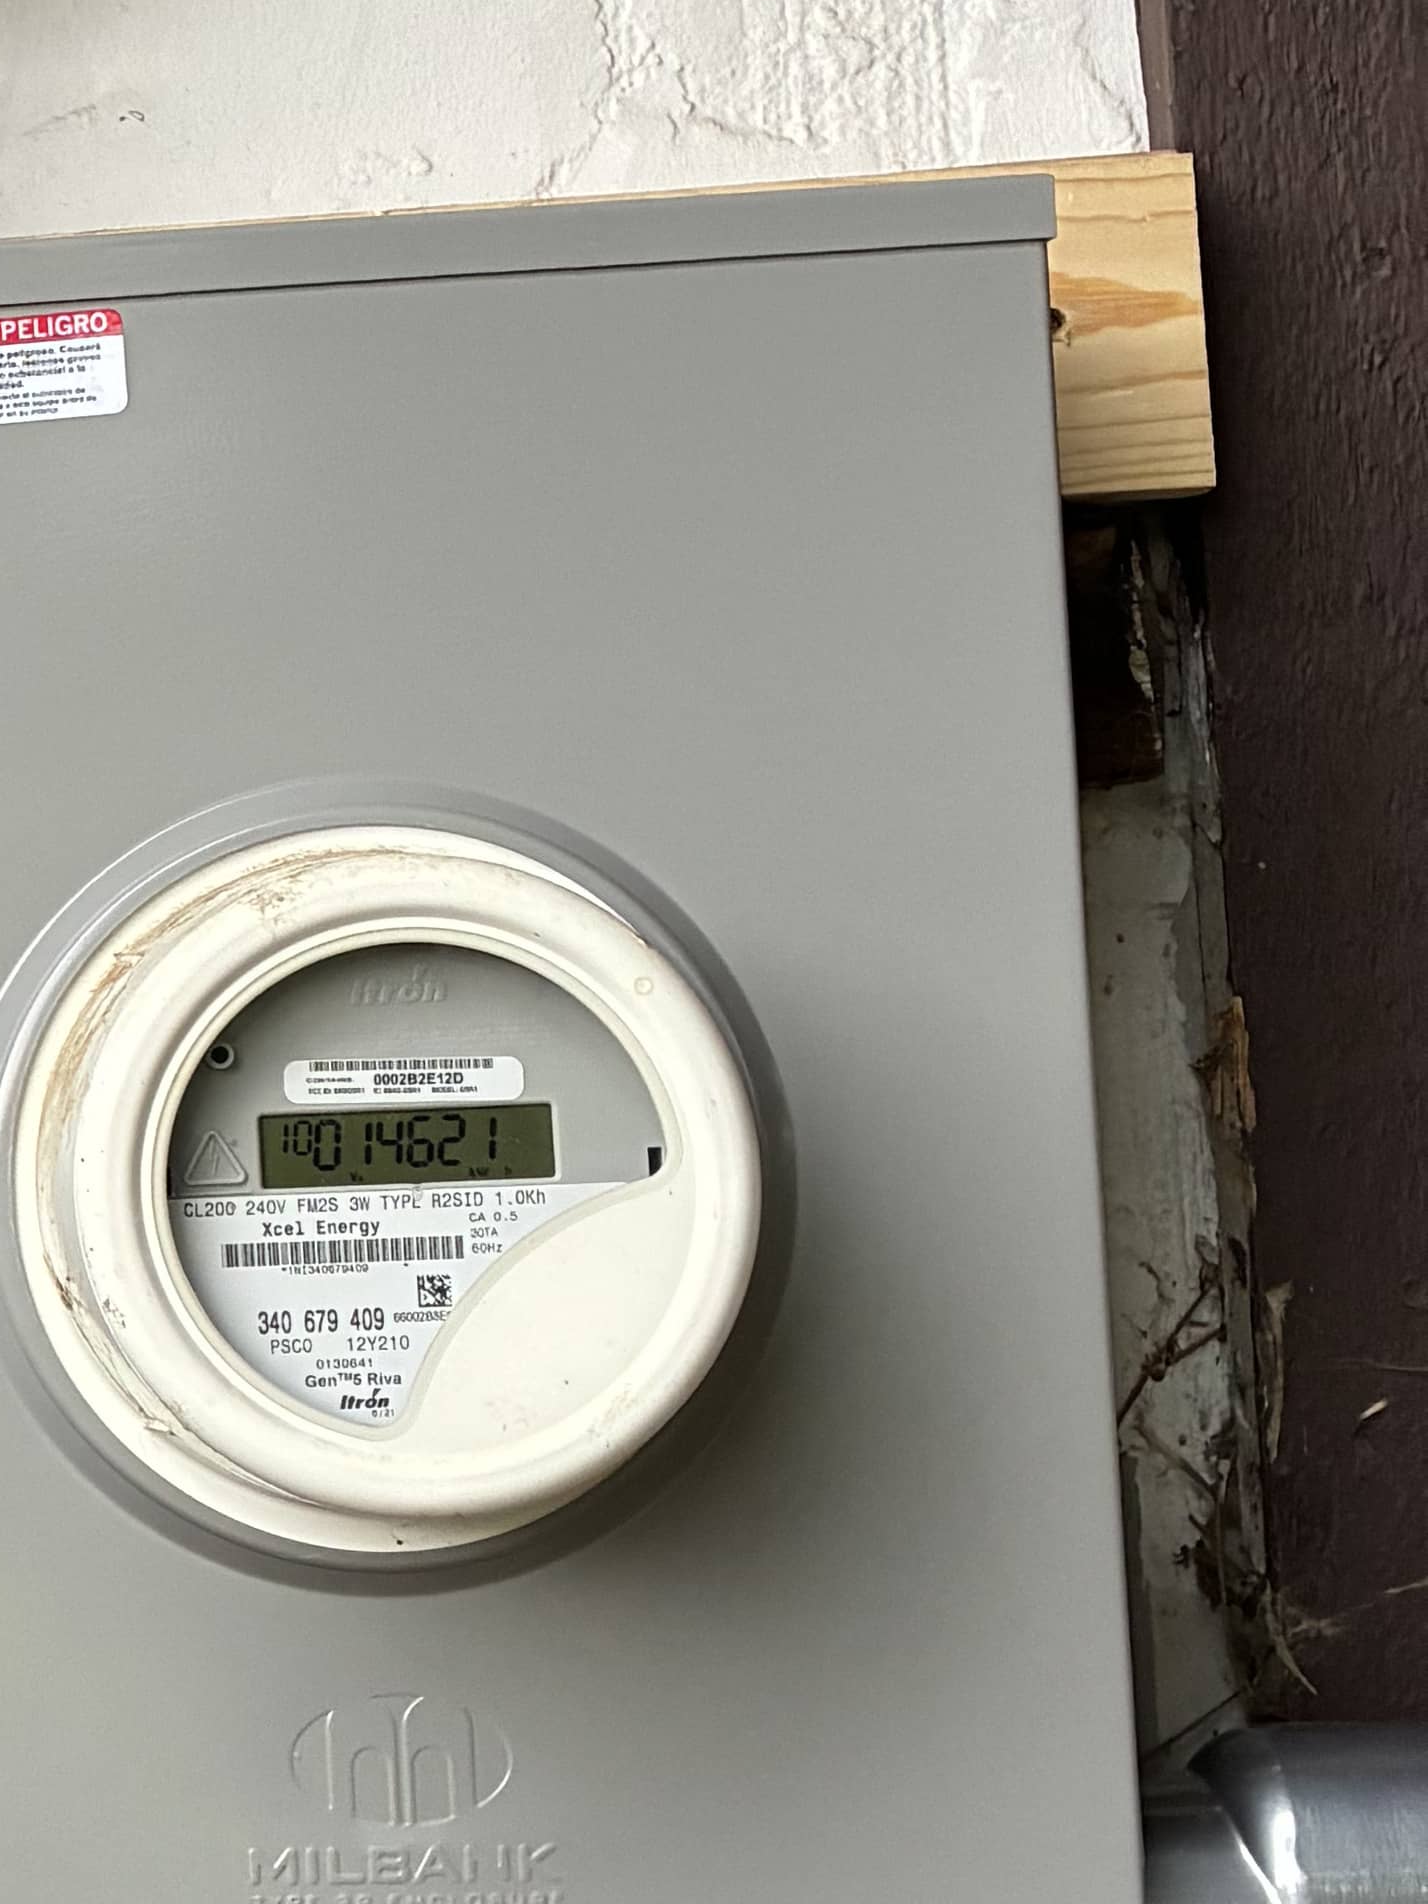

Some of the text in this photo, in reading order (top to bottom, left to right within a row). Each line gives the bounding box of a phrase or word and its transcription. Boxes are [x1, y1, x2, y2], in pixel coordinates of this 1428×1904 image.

[0, 311, 109, 340] PELIGRO
[373, 1072, 464, 1087] 0002B2E12D
[183, 1199, 237, 1219] CL200
[245, 1198, 287, 1215] 240V
[296, 1197, 340, 1213] FM2S
[349, 1196, 371, 1212] 3W
[431, 1191, 484, 1208] R2SID
[495, 1189, 546, 1206] 1.0Kh
[468, 1211, 518, 1222] CA 0.5
[262, 1219, 380, 1237] Xcel Energy
[471, 1242, 503, 1254] 60Hz
[257, 1307, 385, 1335] 340 679 409
[346, 1335, 410, 1352] 12Y210
[367, 1371, 402, 1386] Riva
[246, 1840, 559, 1888] MILBANK
